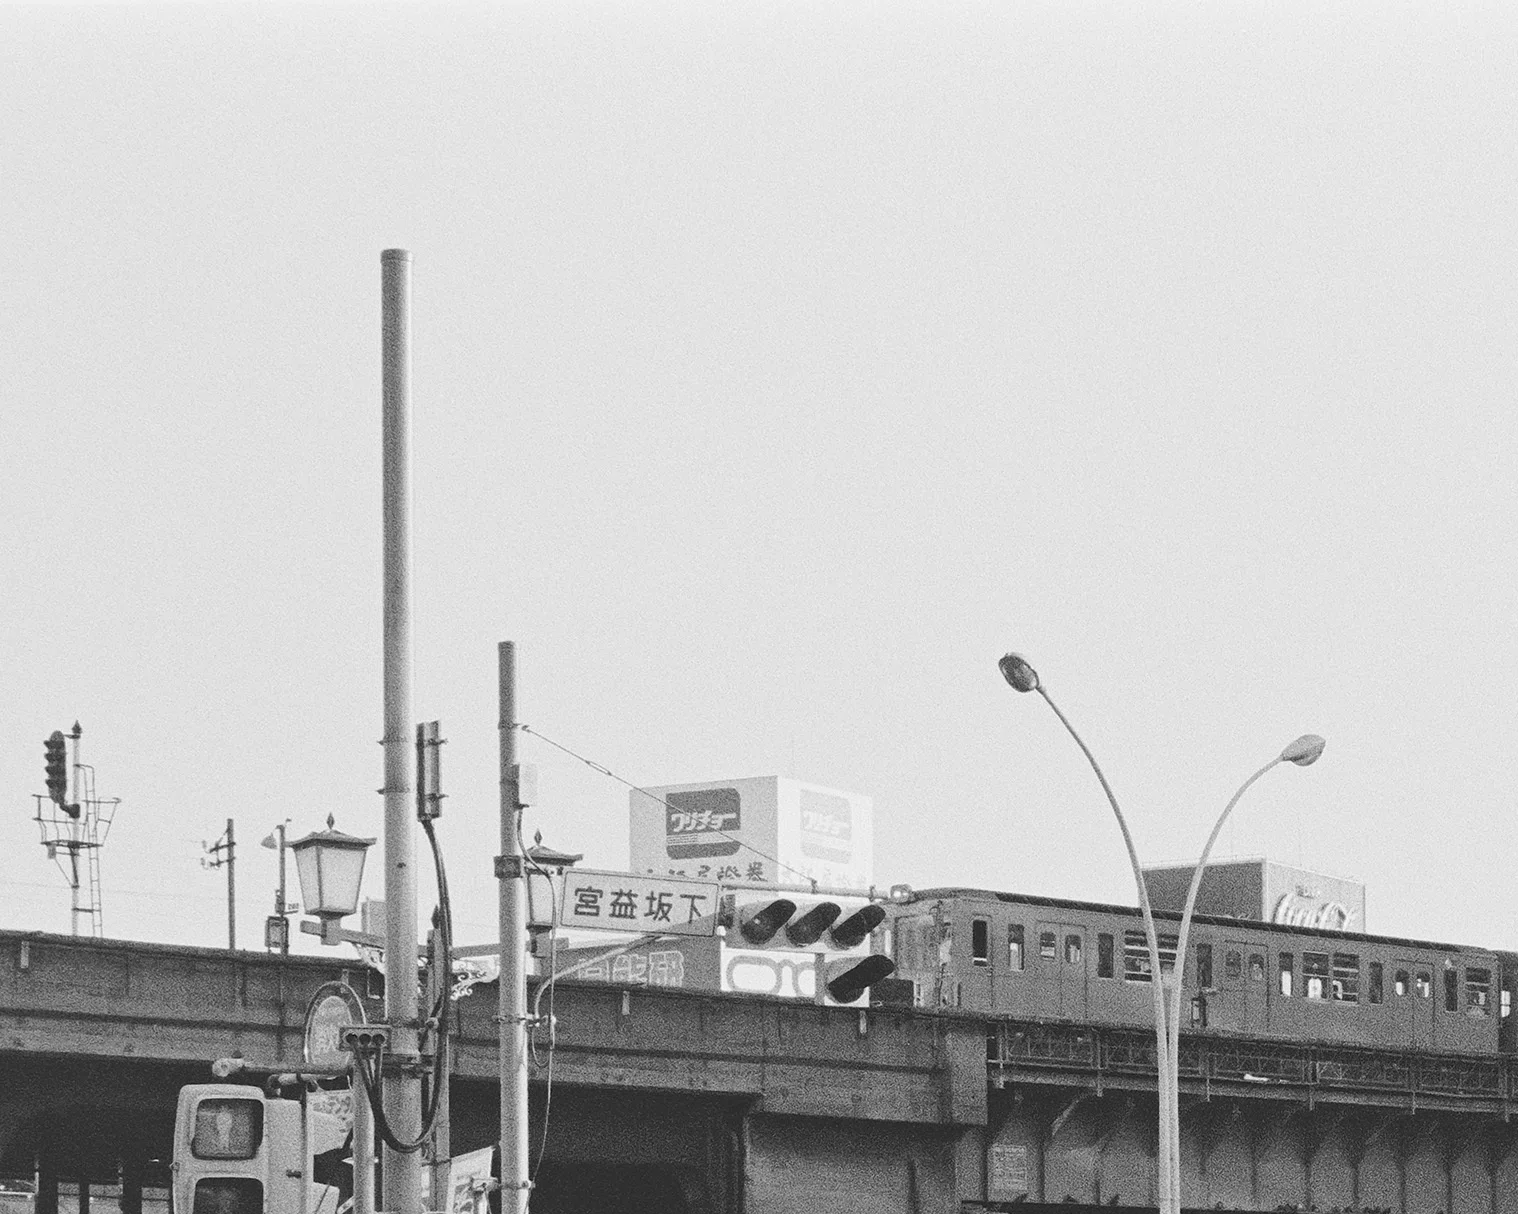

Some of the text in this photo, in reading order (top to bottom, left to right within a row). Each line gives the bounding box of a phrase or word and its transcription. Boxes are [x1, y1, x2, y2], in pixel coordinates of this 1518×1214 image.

[671, 811, 736, 832] ワリチョー
[574, 886, 707, 924] 宮益坂下
